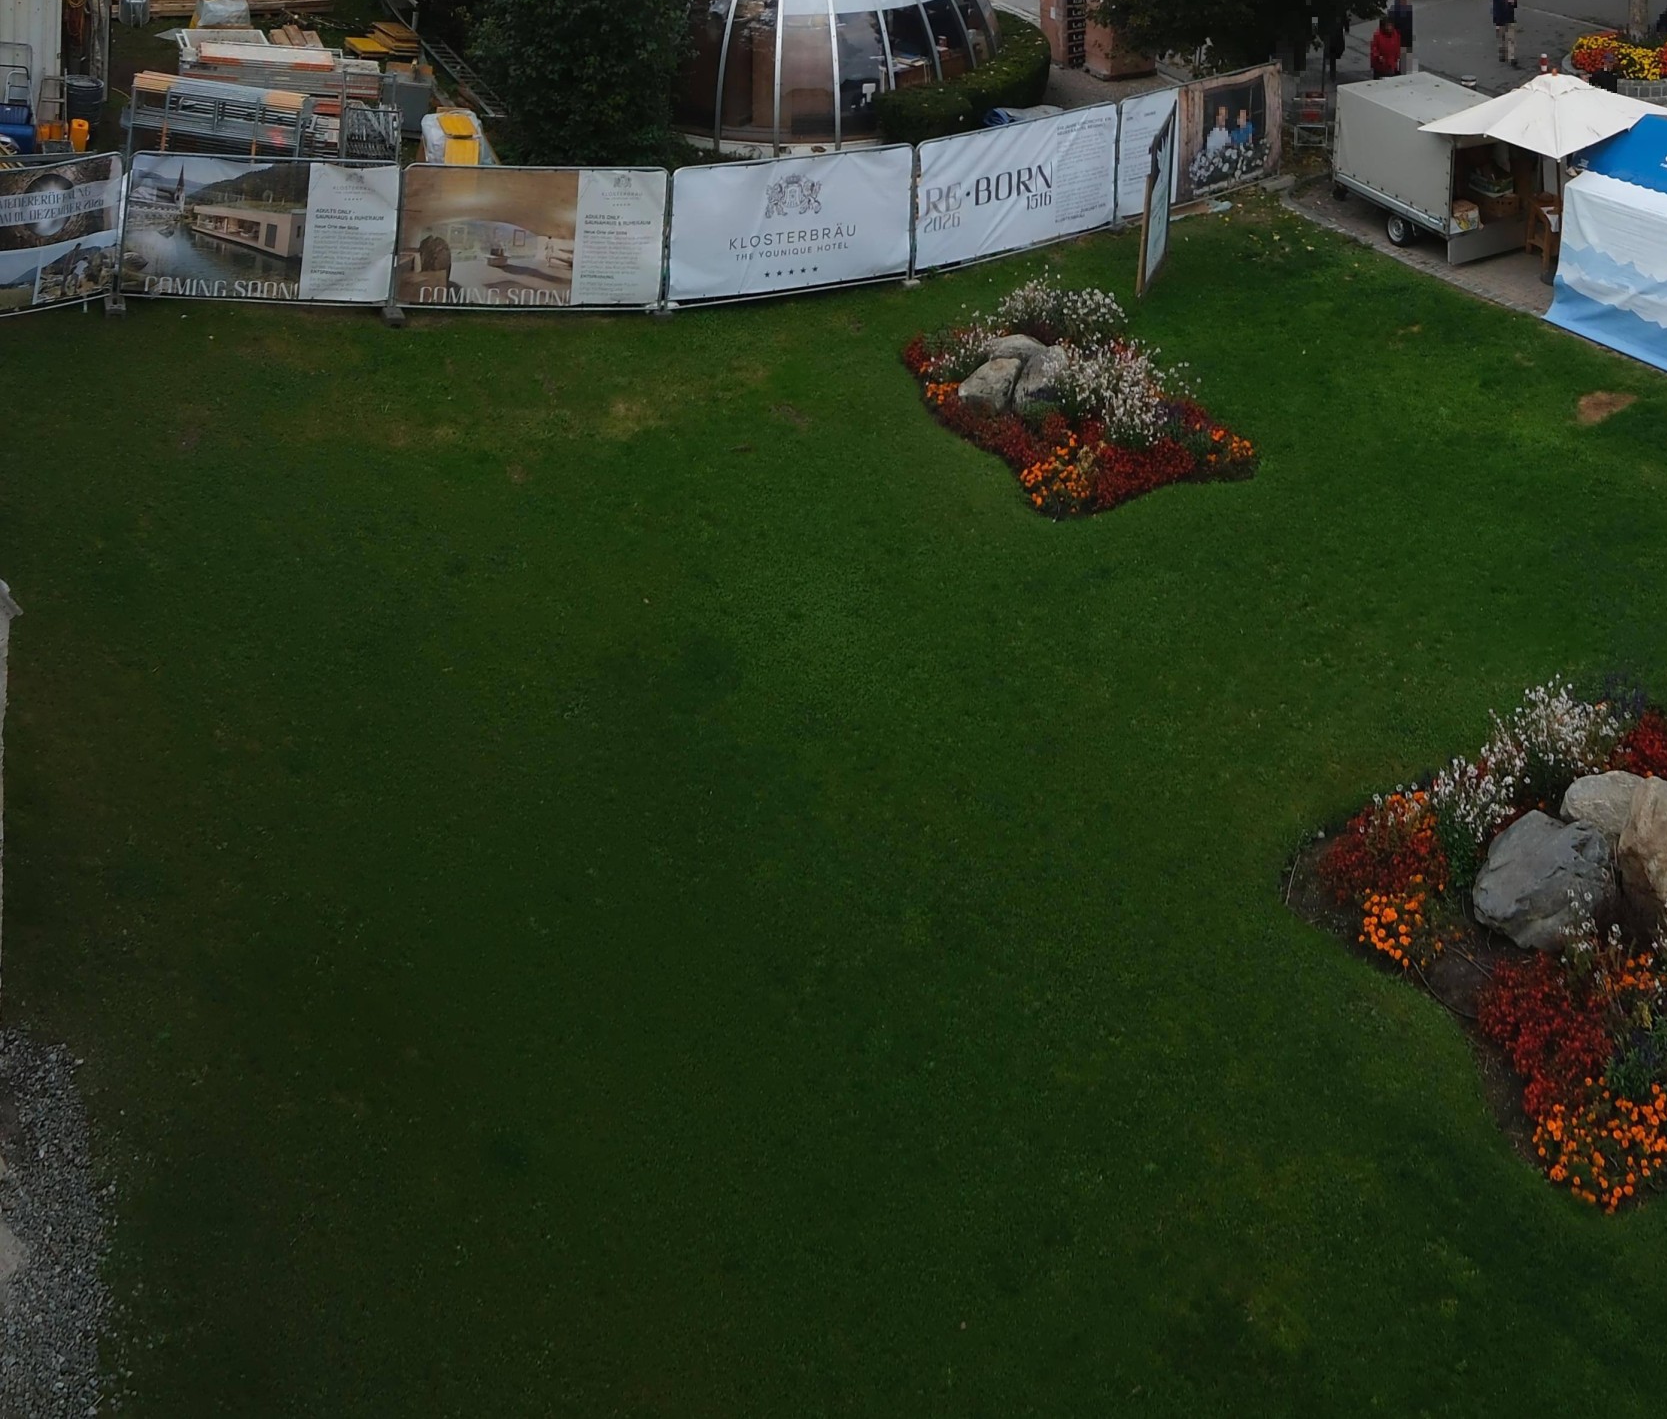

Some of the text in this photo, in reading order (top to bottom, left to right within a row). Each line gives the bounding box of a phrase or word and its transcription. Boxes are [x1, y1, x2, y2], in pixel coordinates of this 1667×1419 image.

[1026, 190, 1052, 211] 1516
[924, 211, 961, 234] 2026
[729, 223, 856, 250] KLOSTERBRÄU
[759, 246, 812, 258] YOUNIQUE
[817, 242, 849, 252] HOTEL
